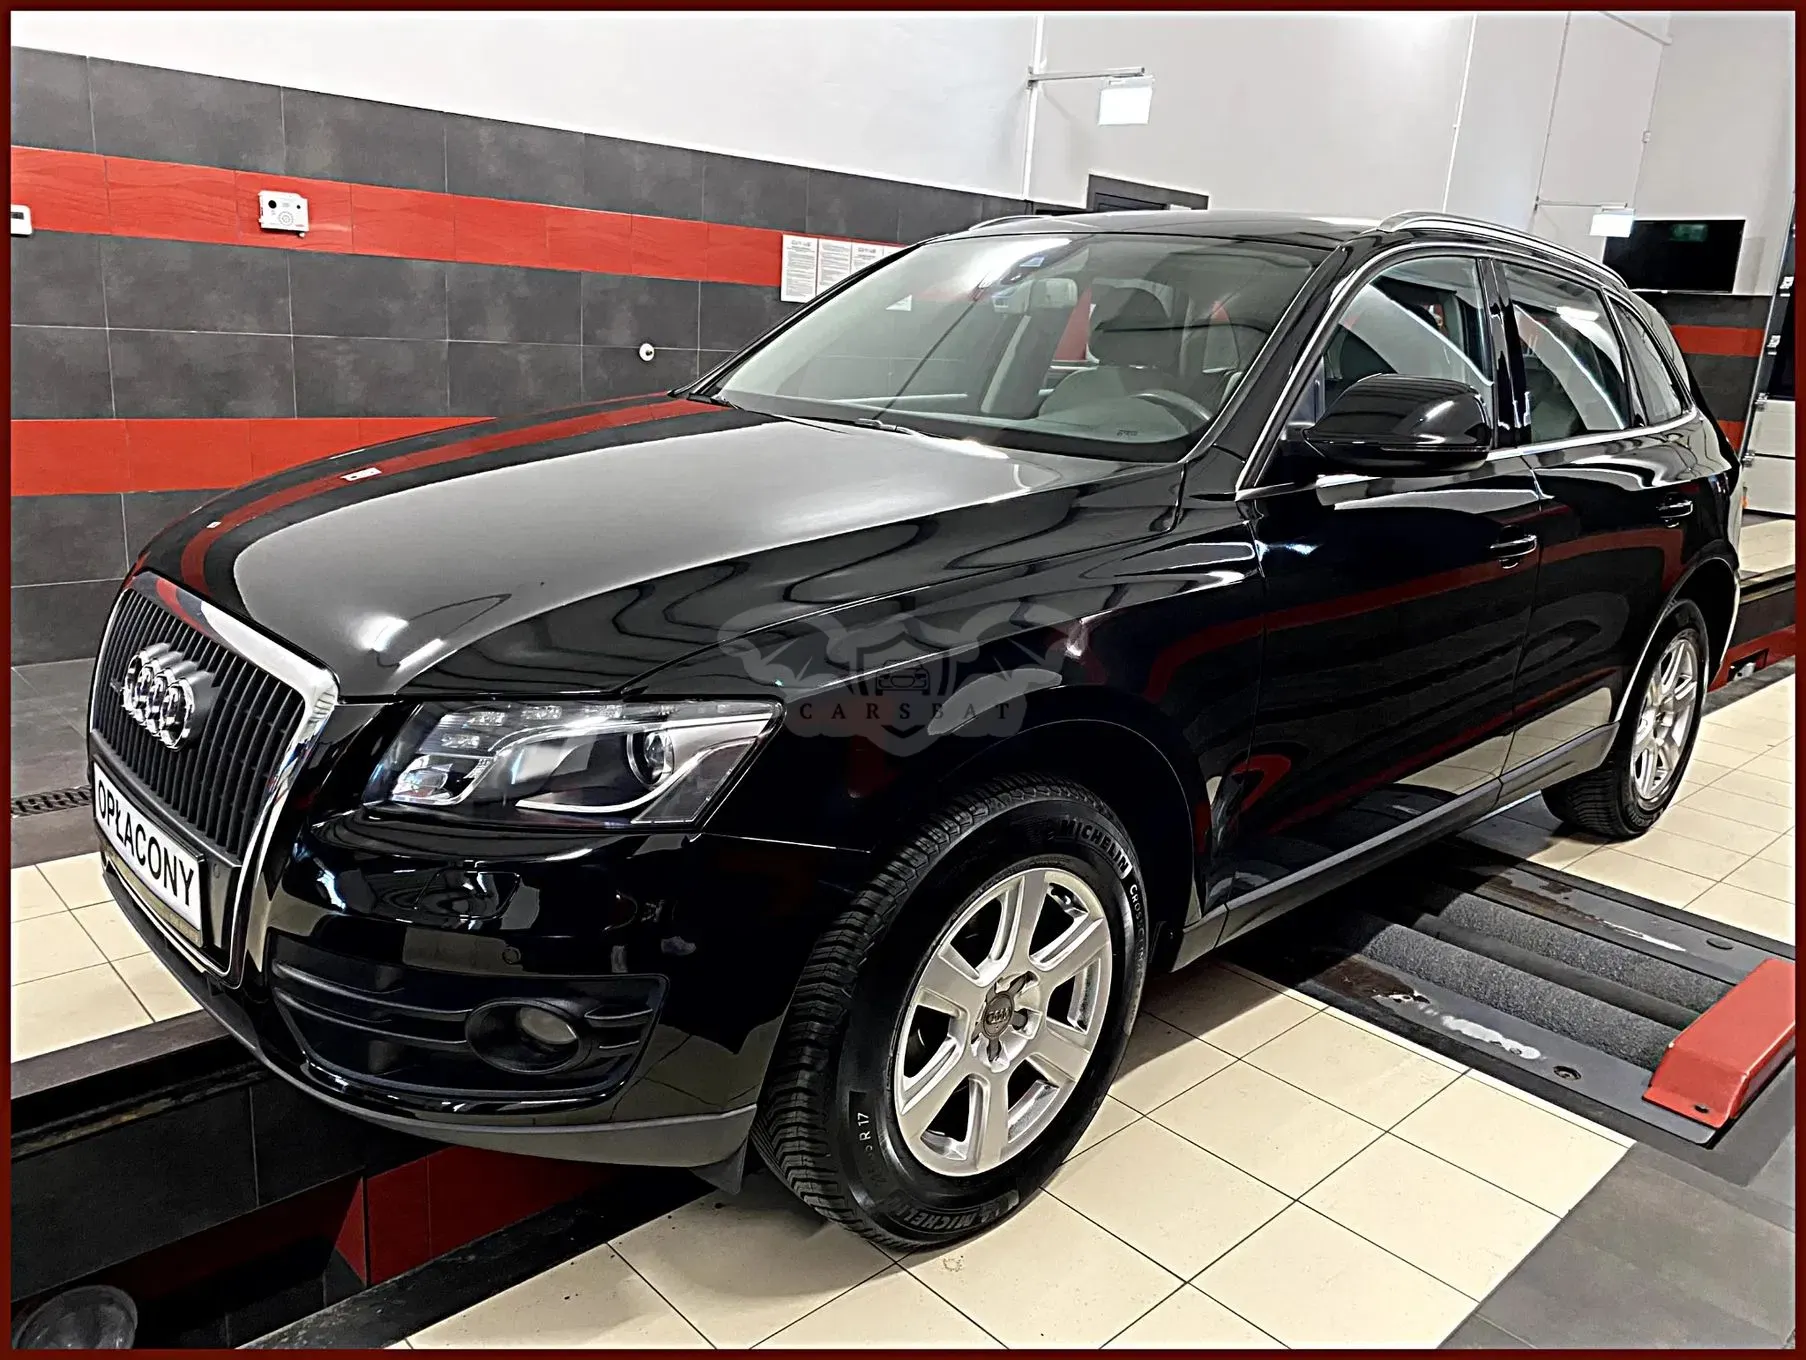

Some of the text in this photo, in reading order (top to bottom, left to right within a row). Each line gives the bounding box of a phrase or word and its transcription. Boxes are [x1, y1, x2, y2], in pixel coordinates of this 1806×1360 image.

[98, 780, 194, 907] OPŁACONY
[1060, 818, 1130, 874] MICHELIN
[857, 1112, 872, 1141] R 17
